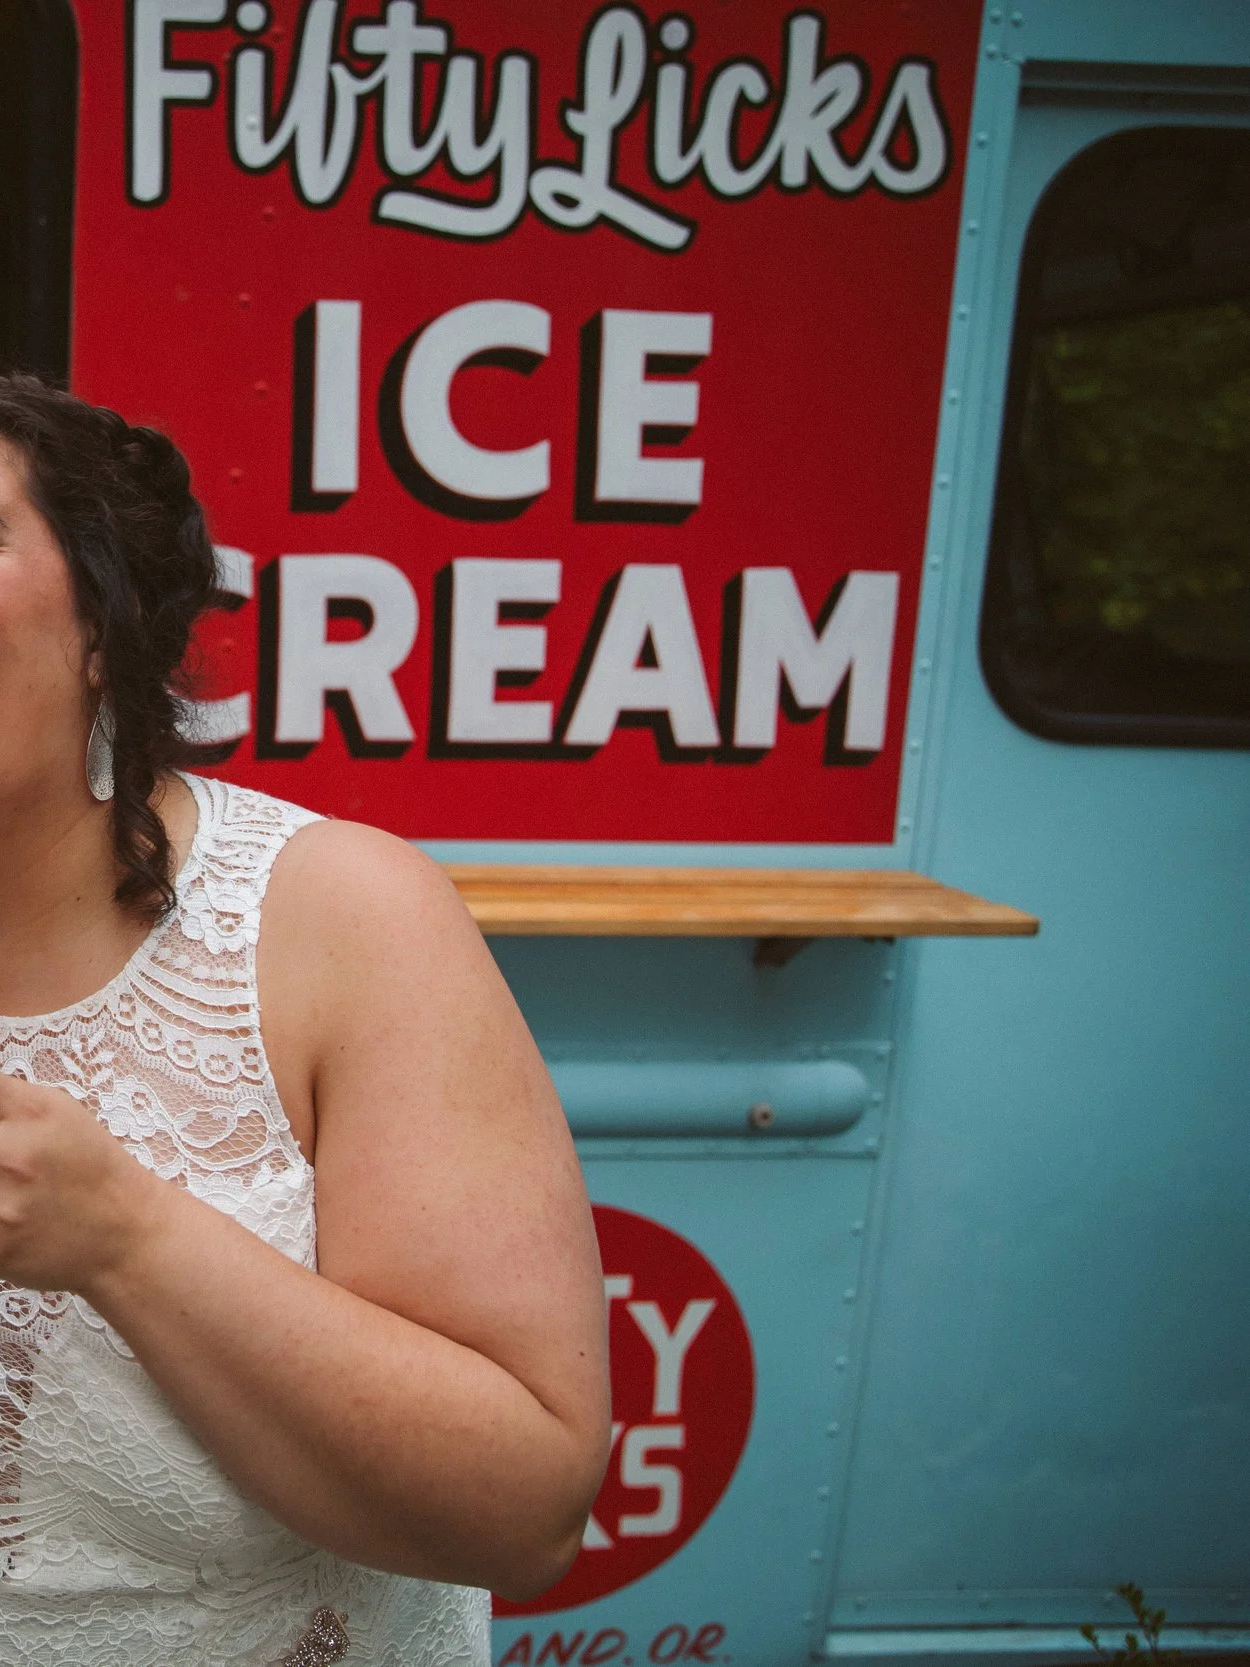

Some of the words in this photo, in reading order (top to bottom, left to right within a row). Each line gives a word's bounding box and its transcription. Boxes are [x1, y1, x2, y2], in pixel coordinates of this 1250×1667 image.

[132, 0, 530, 236] Fifty
[529, 7, 947, 251] Licks
[308, 298, 714, 508] ICE
